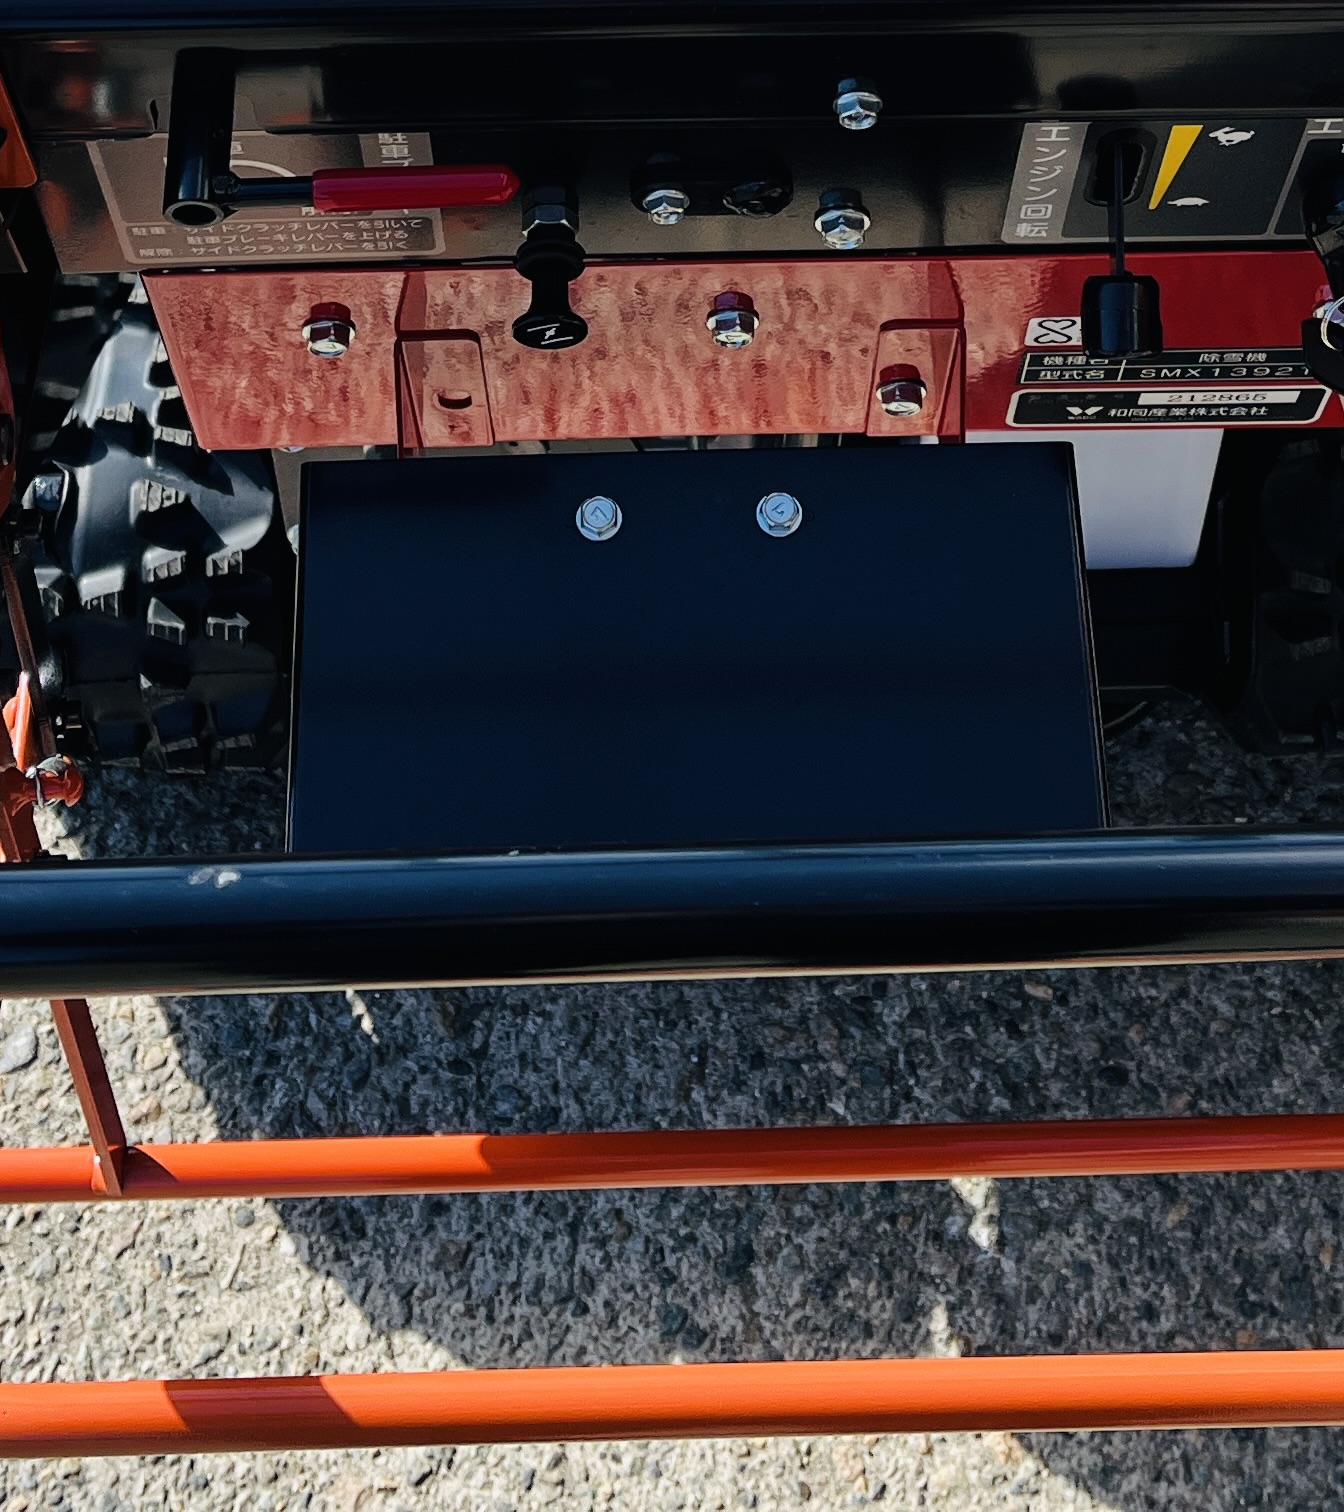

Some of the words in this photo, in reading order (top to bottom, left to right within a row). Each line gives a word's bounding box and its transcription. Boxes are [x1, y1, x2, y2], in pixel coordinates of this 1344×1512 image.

[1015, 126, 1071, 238] エンジン回転
[1198, 352, 1268, 364] 除雪機
[1107, 406, 1269, 419] 和同産業株式会社
